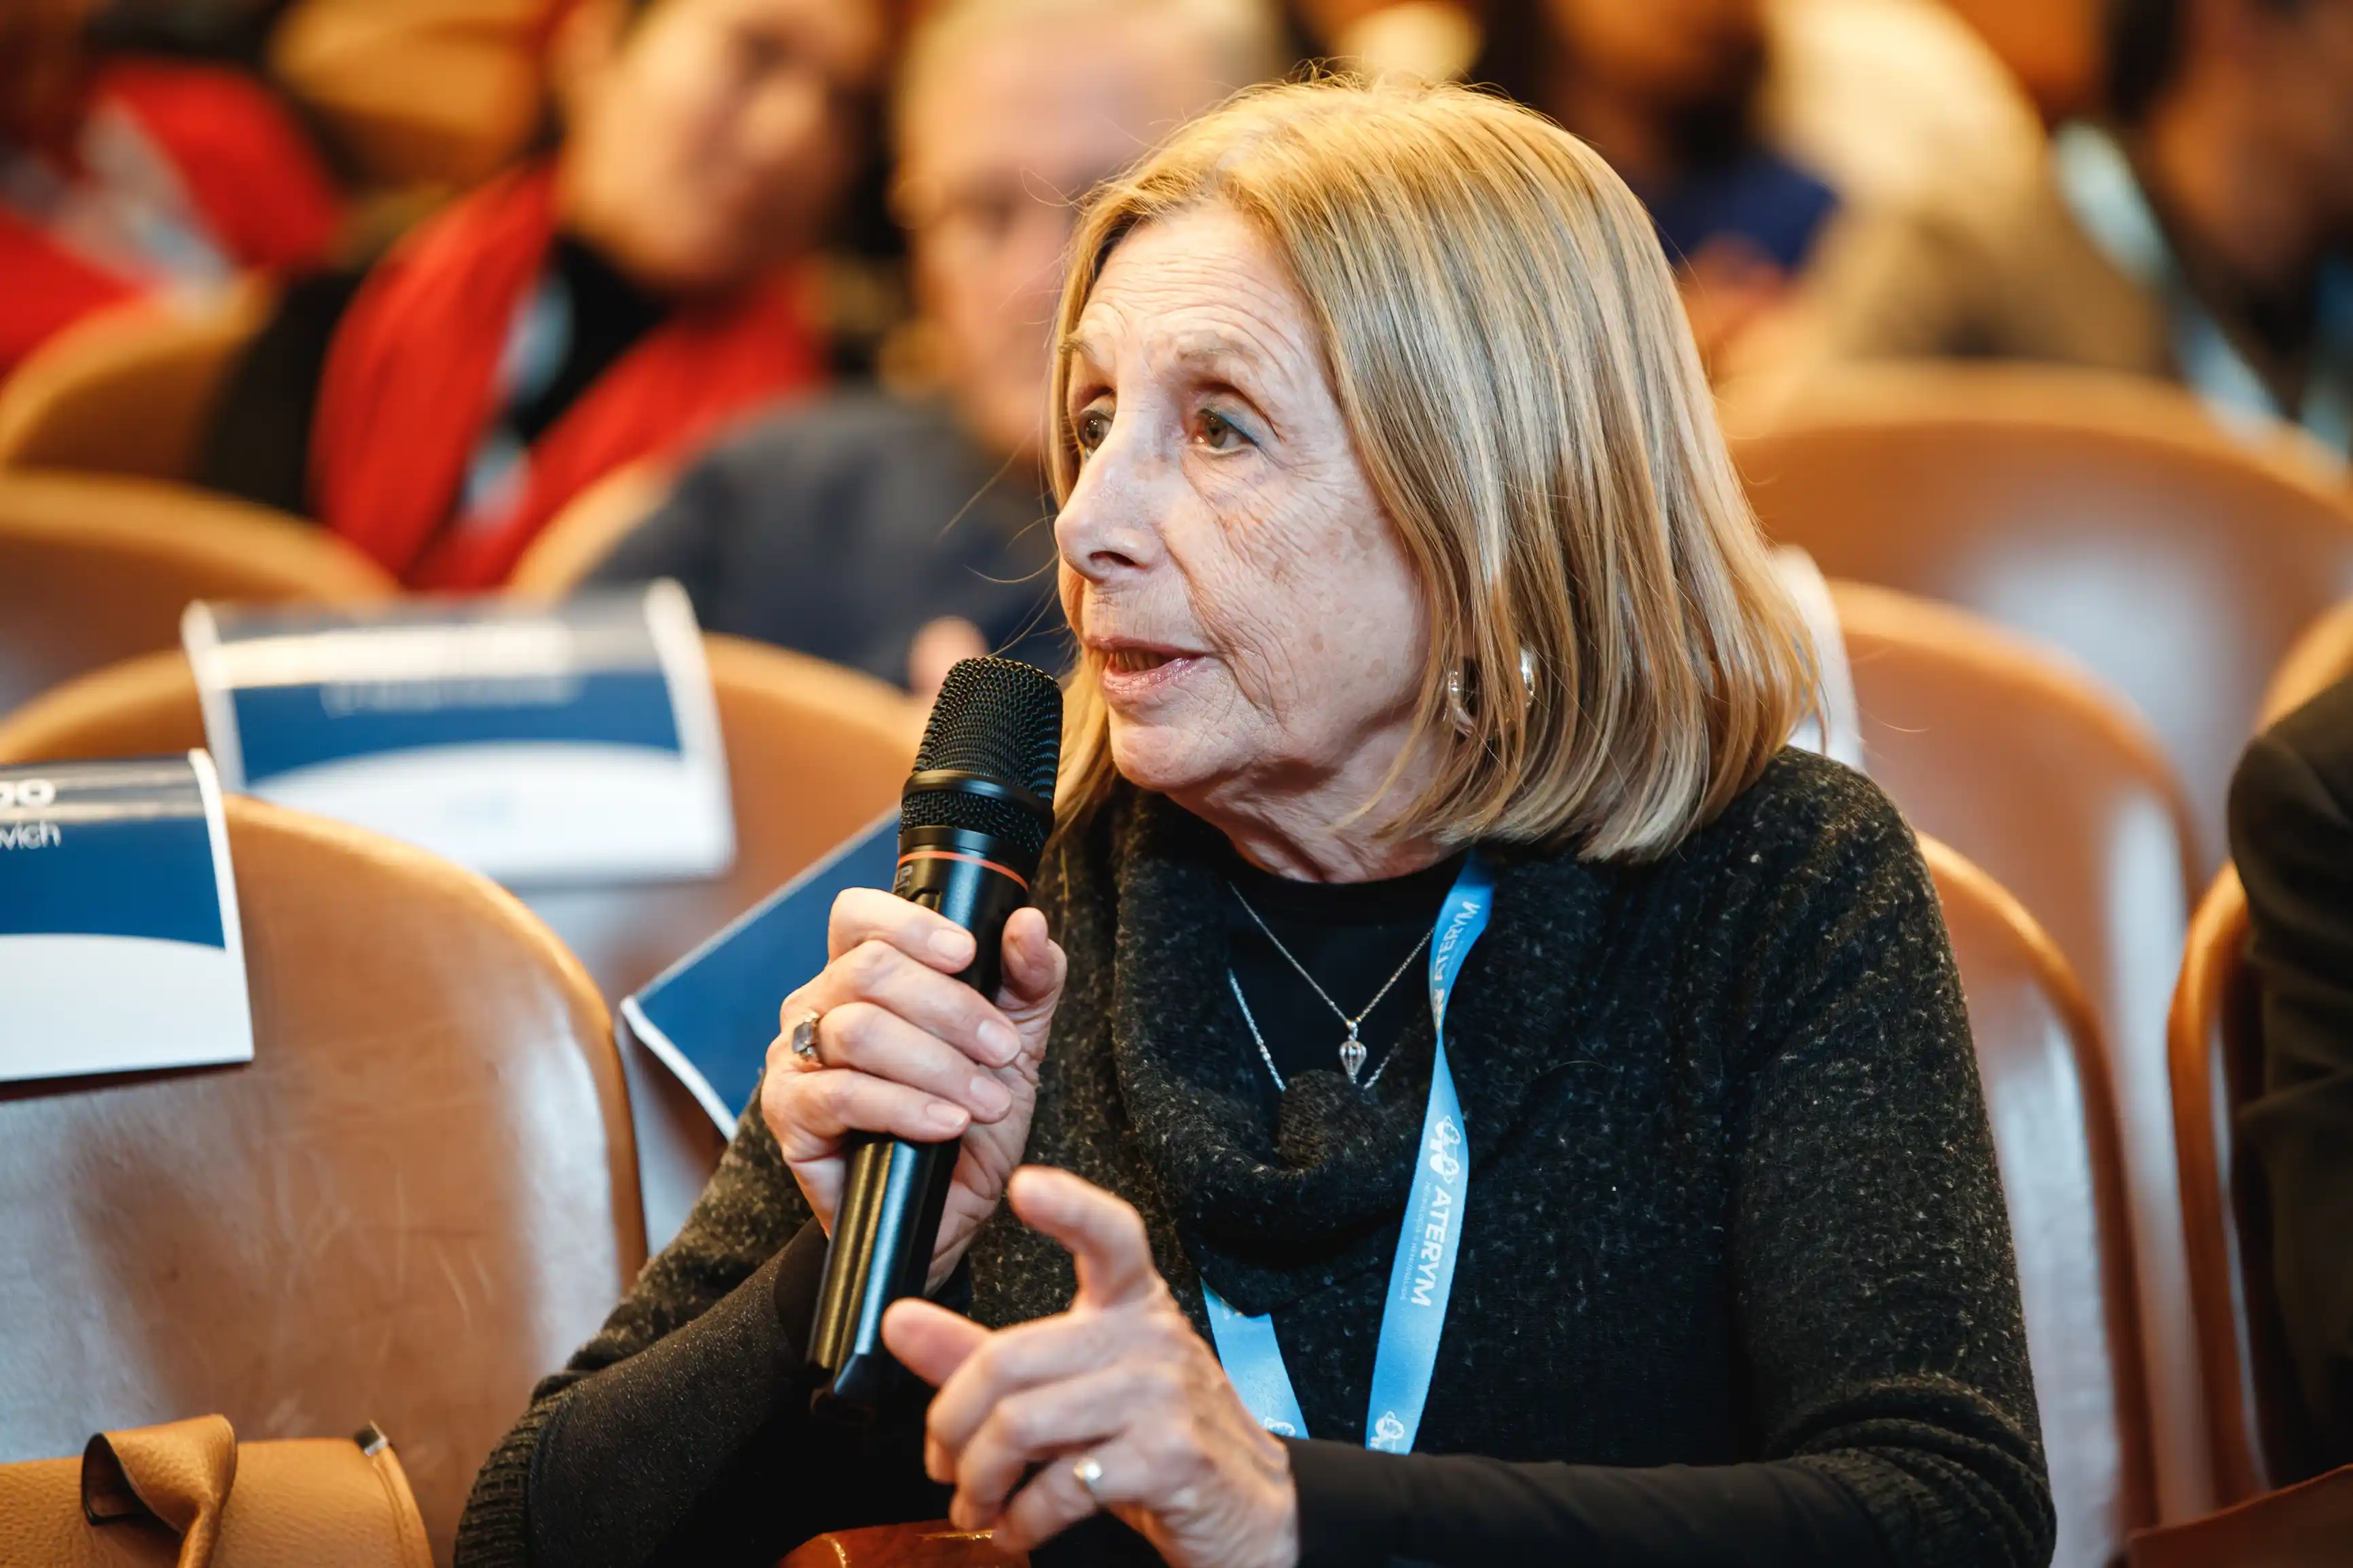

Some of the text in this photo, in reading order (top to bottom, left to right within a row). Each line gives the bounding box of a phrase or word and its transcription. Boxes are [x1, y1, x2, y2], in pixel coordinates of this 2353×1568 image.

[0, 820, 61, 850] vich
[1434, 900, 1481, 981] ATERYM
[1411, 1185, 1452, 1307] ATERYM
